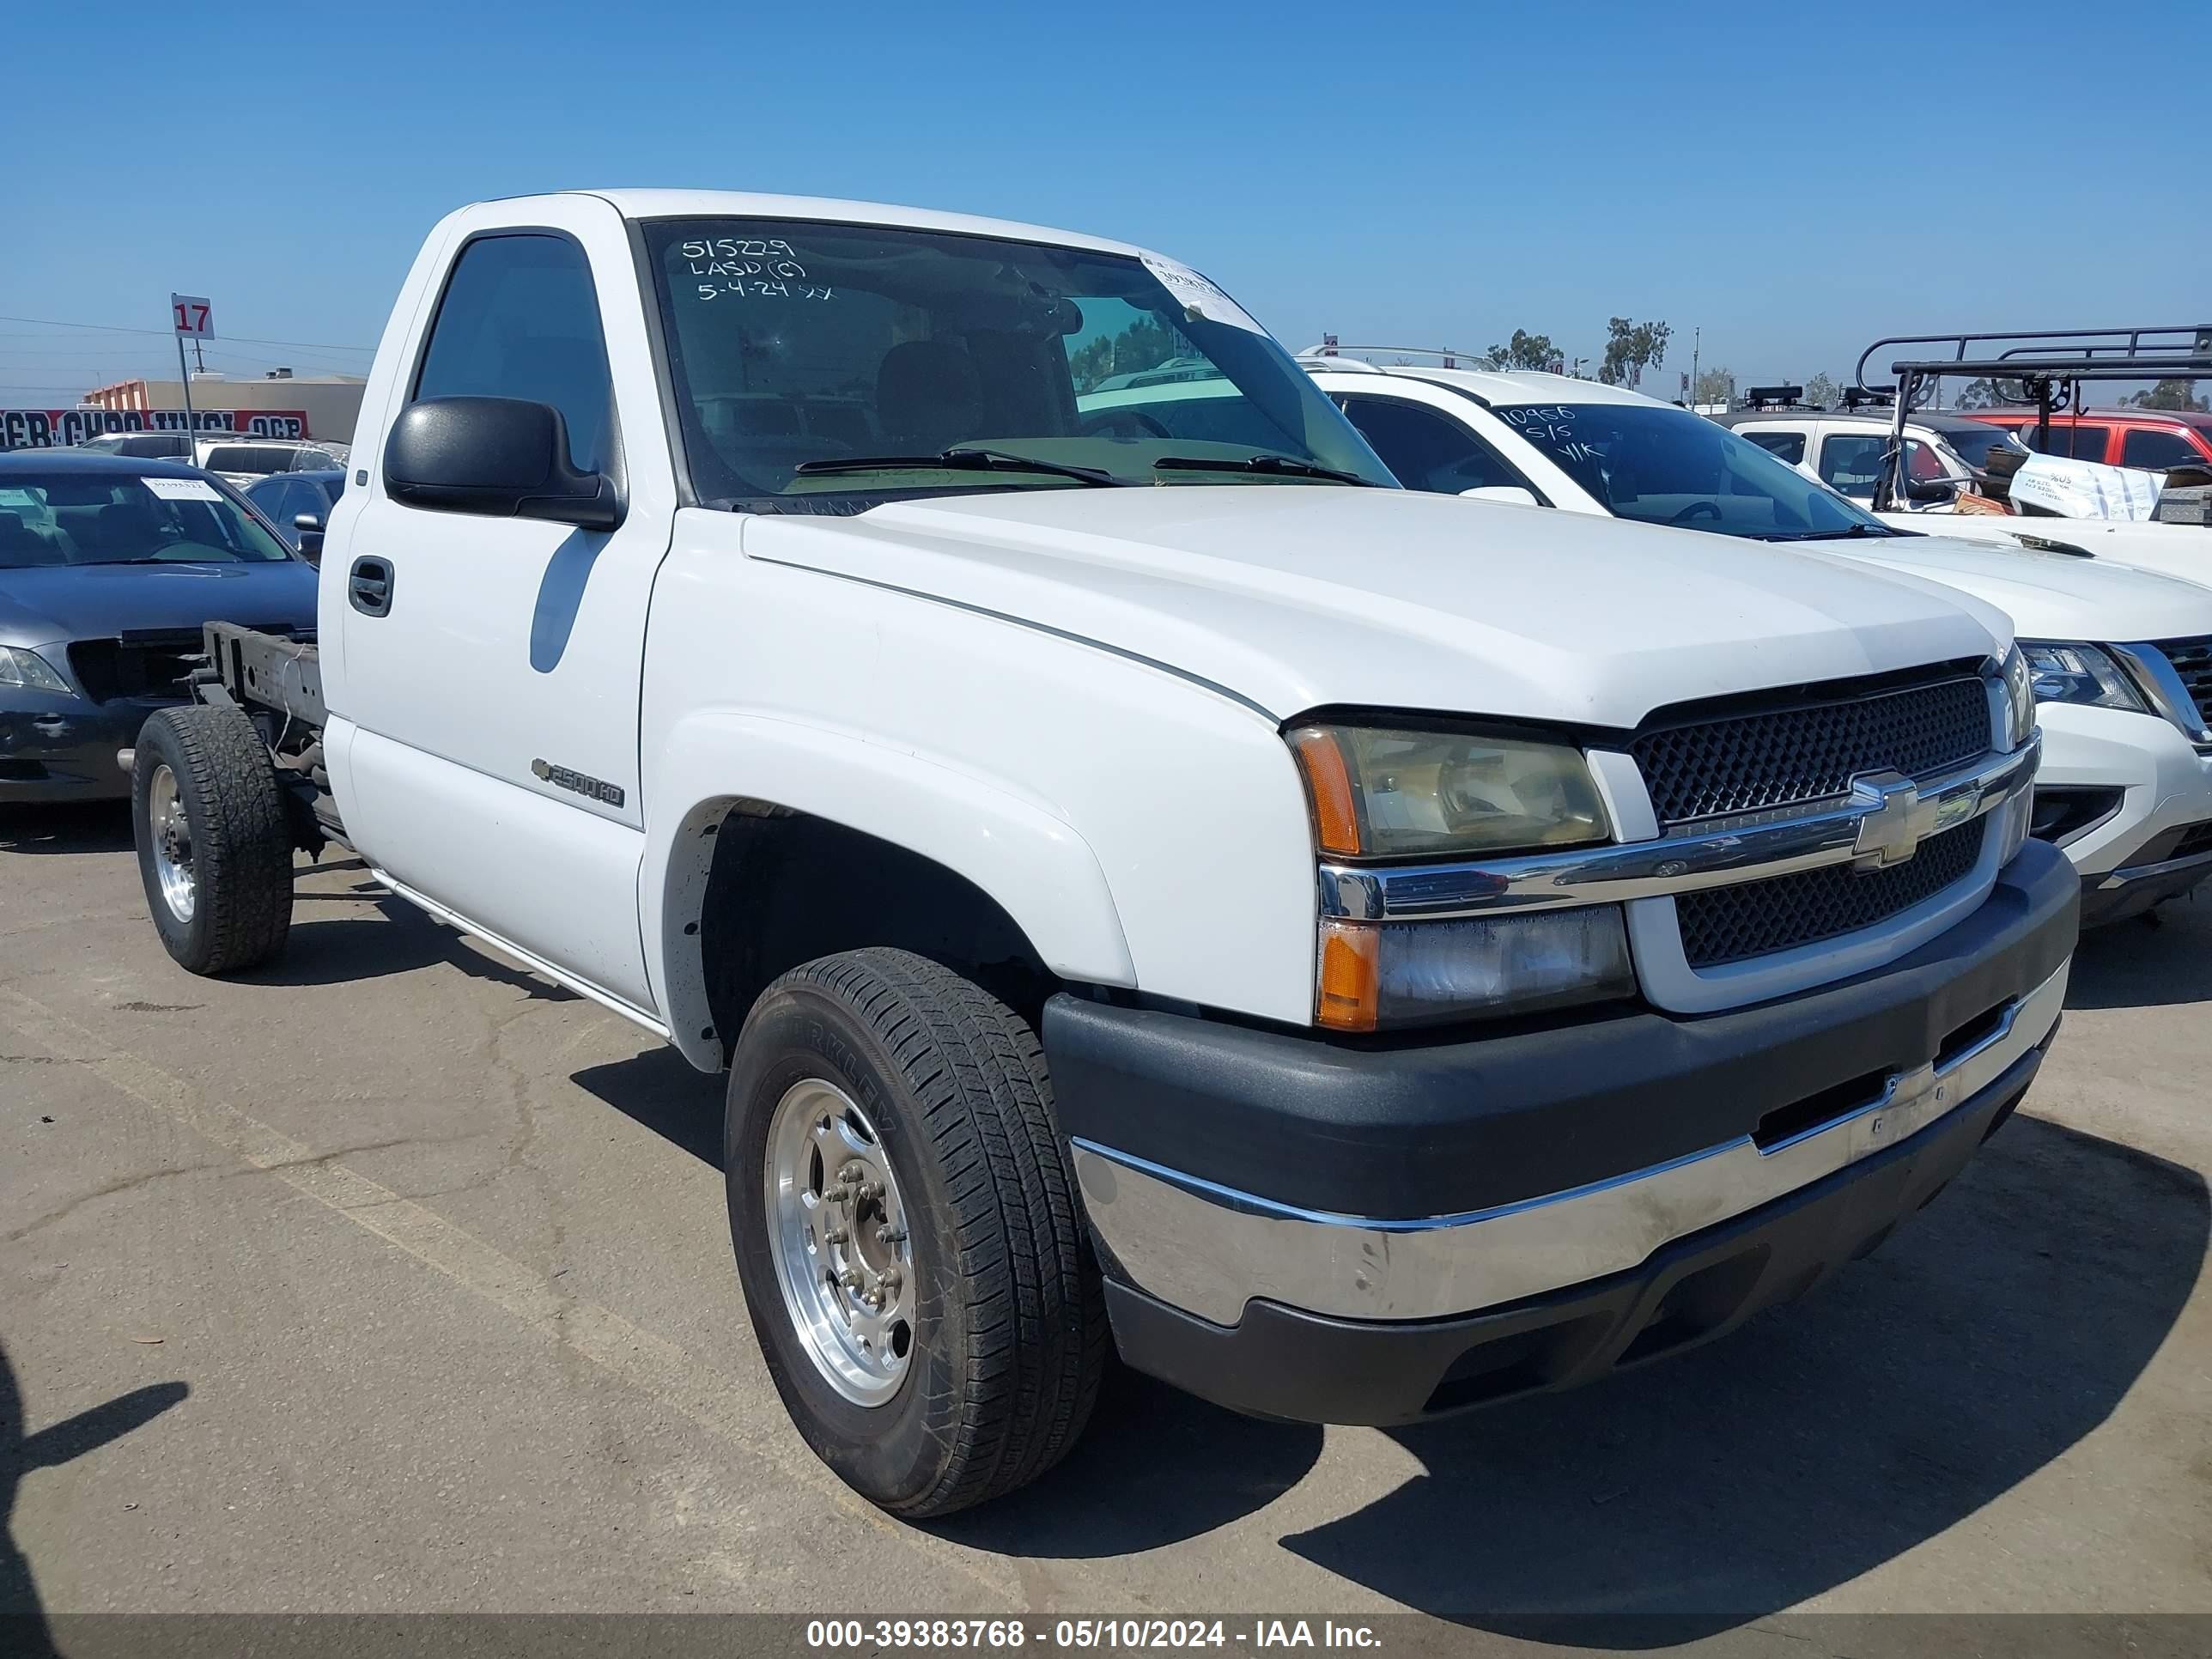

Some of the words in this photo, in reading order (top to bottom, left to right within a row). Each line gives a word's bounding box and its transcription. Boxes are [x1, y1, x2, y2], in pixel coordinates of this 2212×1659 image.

[683, 239, 797, 258] 515229
[698, 279, 789, 300] 5-4-24
[174, 303, 209, 331] 17
[1634, 369, 1639, 383] 9
